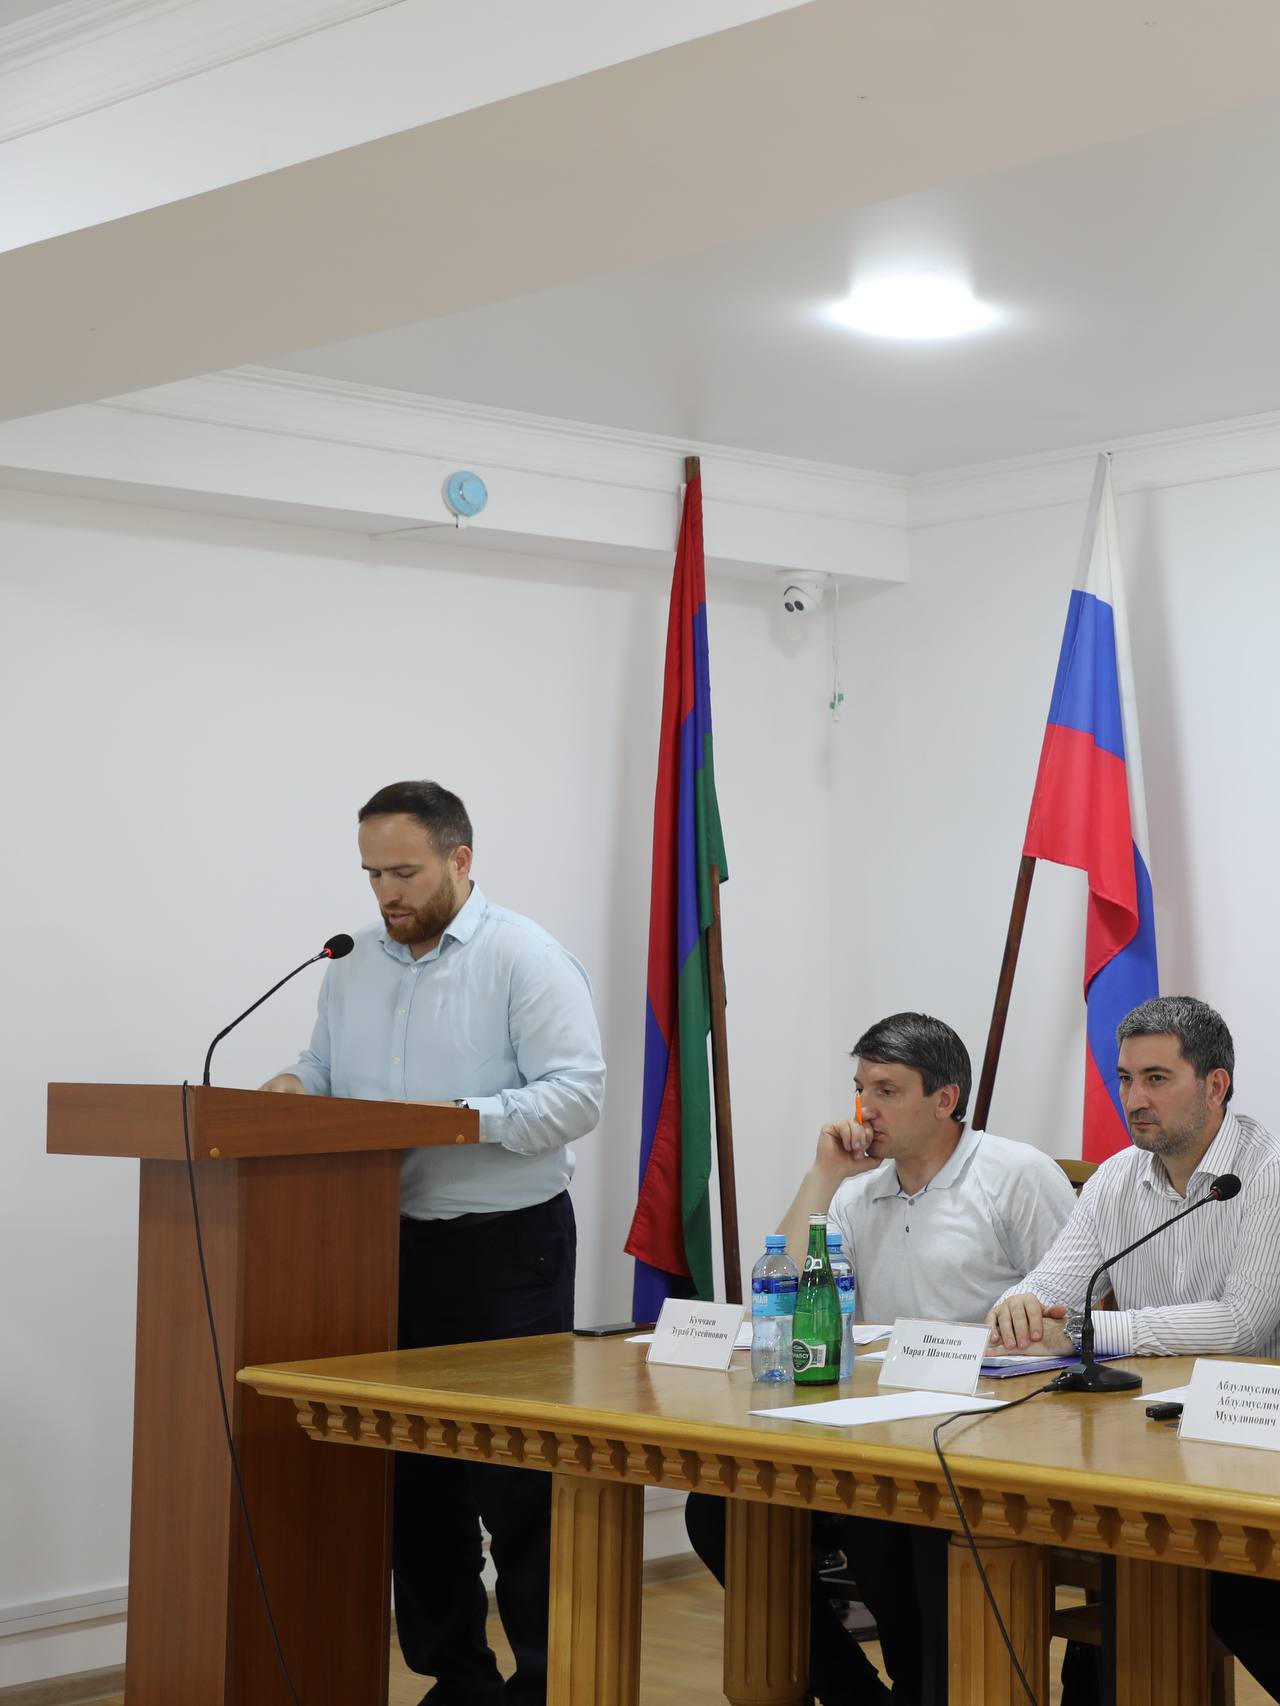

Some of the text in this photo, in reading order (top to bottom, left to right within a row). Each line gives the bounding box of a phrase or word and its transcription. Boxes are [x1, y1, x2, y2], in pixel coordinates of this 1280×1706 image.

[922, 1334, 962, 1346] Шихалиев
[902, 1346, 977, 1361] Марат Шамильевич
[1218, 1396, 1280, 1412] Абдулмуслим
